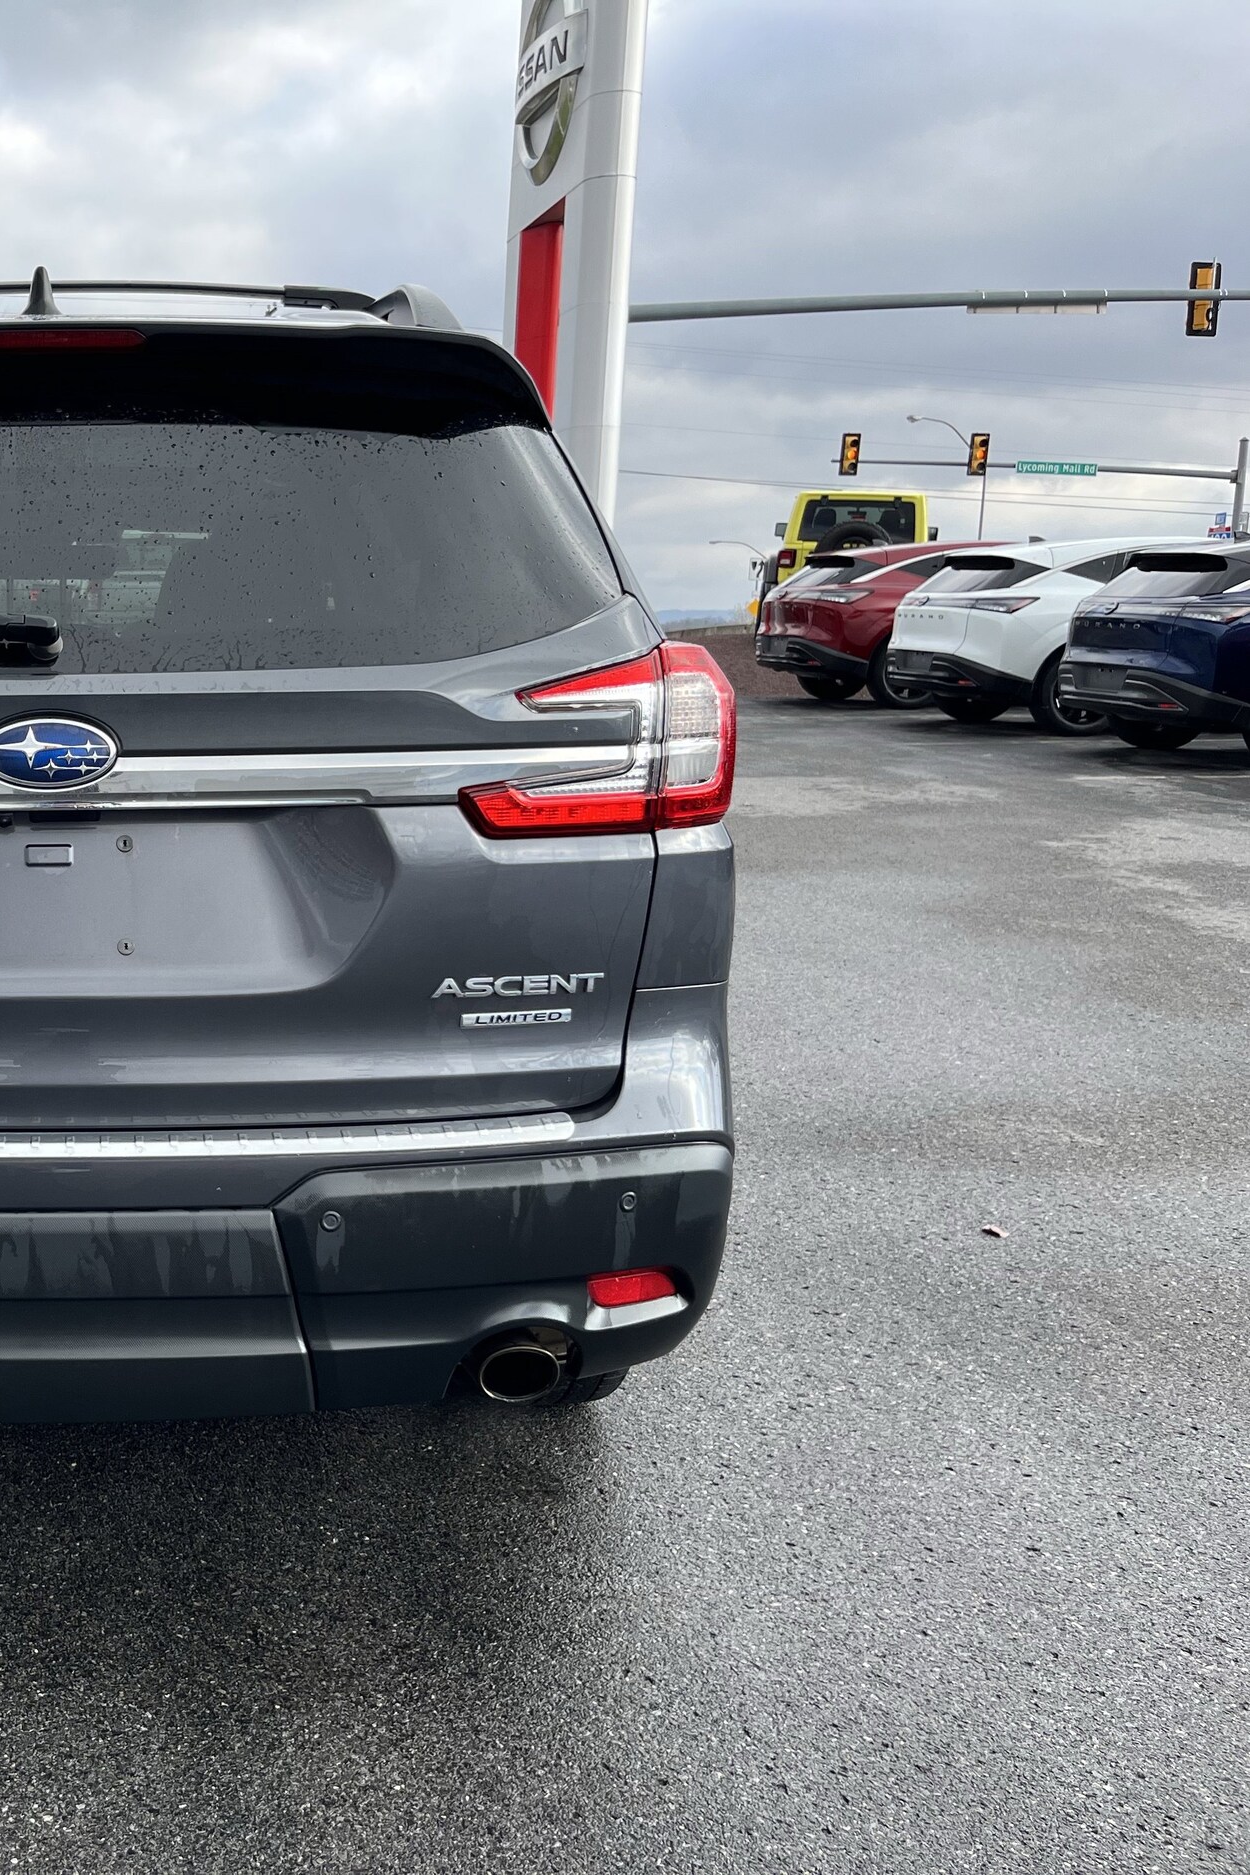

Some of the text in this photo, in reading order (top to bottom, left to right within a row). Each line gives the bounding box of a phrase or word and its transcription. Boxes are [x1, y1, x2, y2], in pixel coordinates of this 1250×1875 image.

[518, 29, 569, 97] SSAN
[1018, 462, 1096, 474] Lycoming Mall Rd
[431, 972, 604, 999] ASCENT
[474, 1011, 563, 1025] LIMITED
